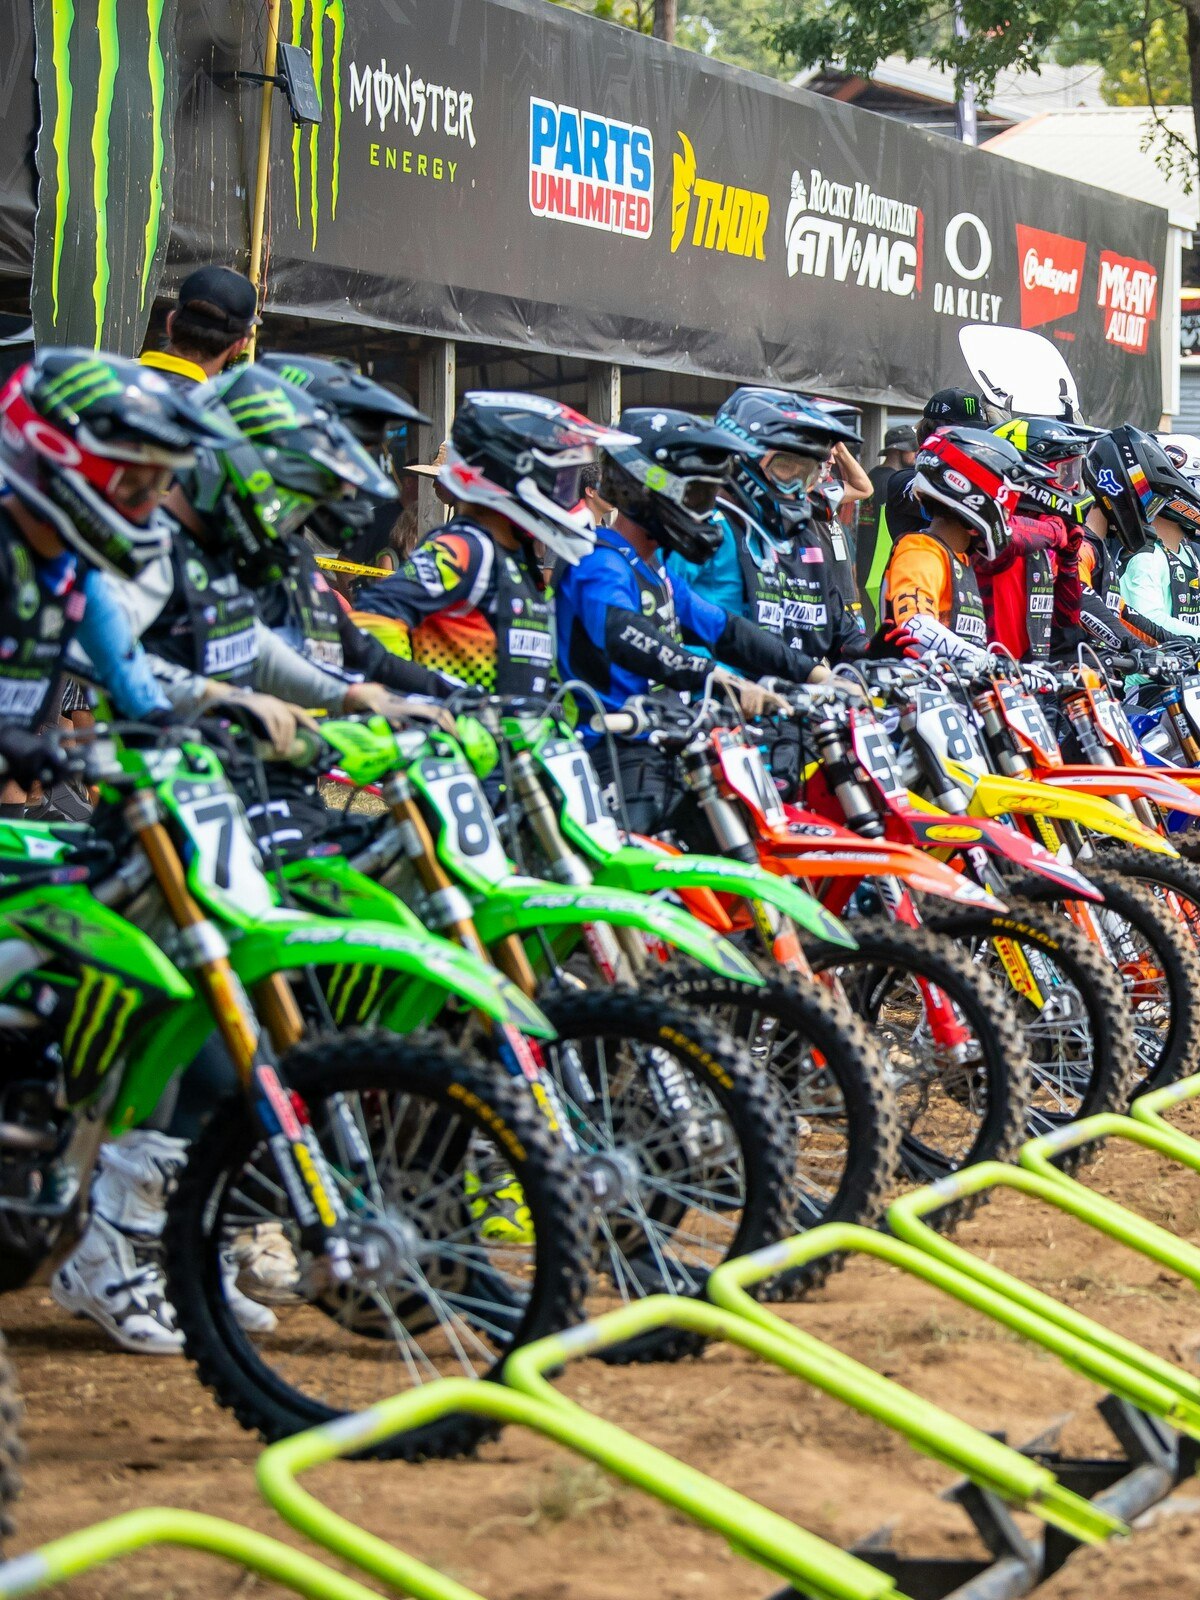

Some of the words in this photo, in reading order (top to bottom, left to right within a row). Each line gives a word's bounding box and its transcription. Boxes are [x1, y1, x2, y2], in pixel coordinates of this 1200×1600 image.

[349, 58, 476, 148] MONSTER
[369, 143, 458, 183] ENERGY
[531, 102, 651, 192] PARTS
[531, 170, 651, 235] UNLIMITED
[692, 180, 770, 260] THOR
[808, 169, 854, 220] ROCKY
[853, 182, 918, 239] MOUNTAIN
[1023, 247, 1078, 296] Polisport
[933, 282, 1003, 324] OAKLEY
[1122, 445, 1135, 465] FOX
[736, 471, 766, 500] FLY
[947, 473, 966, 490] BELL
[619, 624, 660, 655] FLY
[938, 707, 974, 763] 8
[448, 781, 491, 857] 8
[194, 802, 233, 890] 7
[991, 917, 1060, 951] DUNLOP
